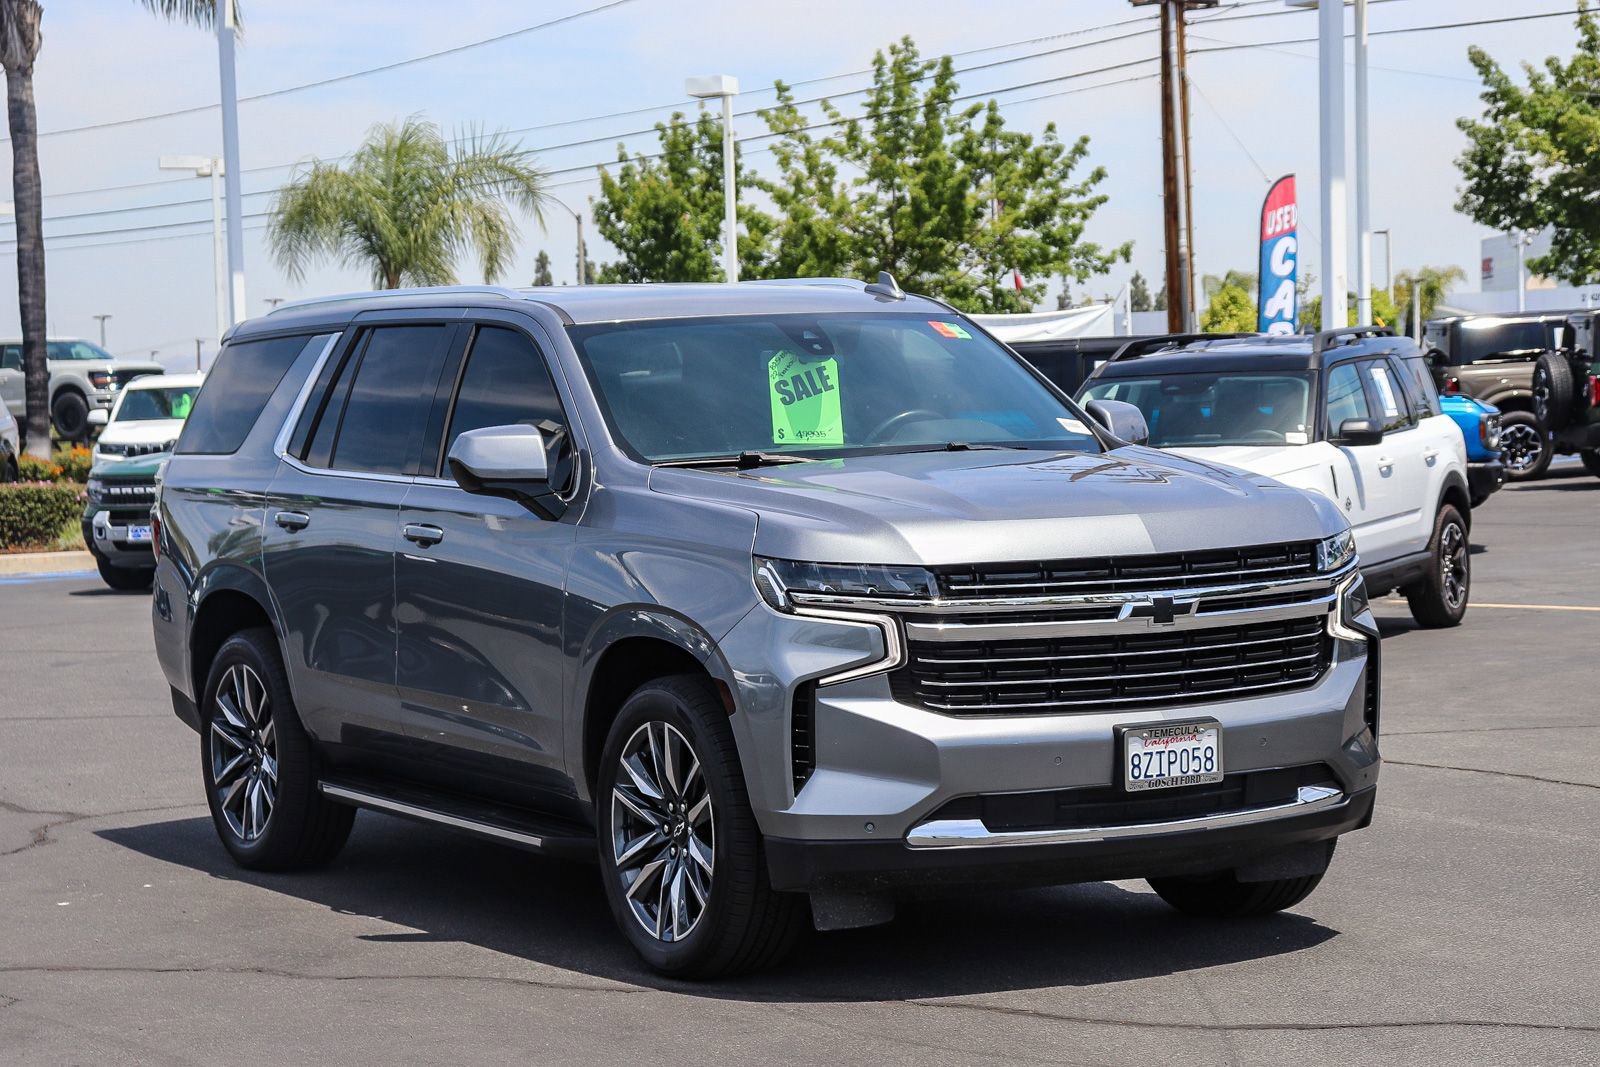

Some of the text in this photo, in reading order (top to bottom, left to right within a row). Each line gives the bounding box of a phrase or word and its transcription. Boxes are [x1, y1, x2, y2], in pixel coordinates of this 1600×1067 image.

[1266, 203, 1298, 235] USED
[774, 366, 834, 406] SALE
[778, 428, 785, 440] $
[1148, 726, 1200, 738] TEMECULA
[1144, 734, 1202, 749] California
[1131, 746, 1214, 780] 8ZIP058
[1148, 776, 1179, 789] GOSCH
[1180, 774, 1201, 785] FORD
